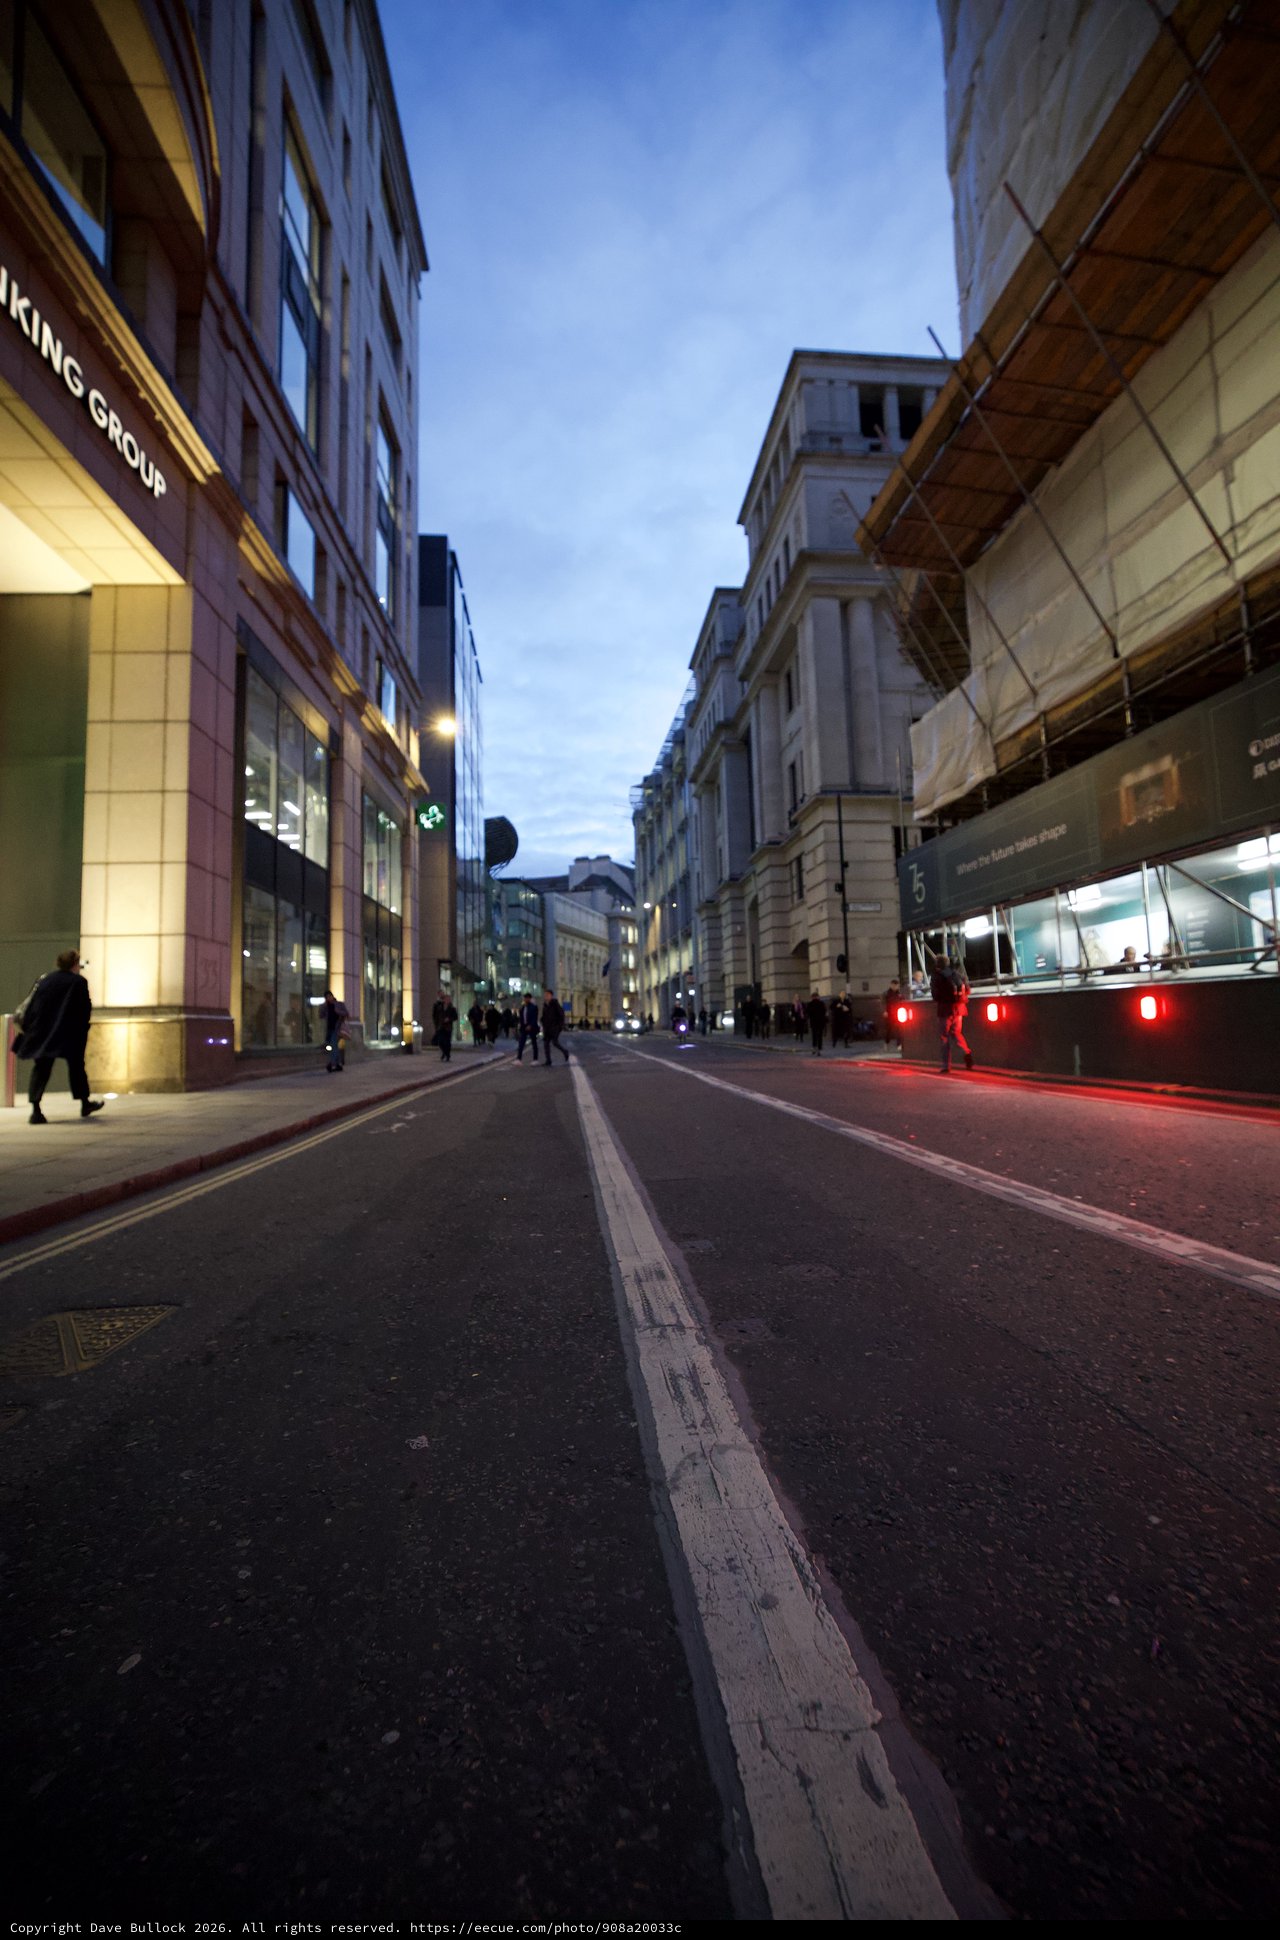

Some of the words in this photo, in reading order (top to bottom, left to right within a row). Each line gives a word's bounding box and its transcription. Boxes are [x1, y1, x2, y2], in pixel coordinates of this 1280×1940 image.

[89, 389, 168, 499] GROUP
[957, 860, 978, 876] Where
[978, 855, 991, 868] the
[991, 845, 1015, 861] future
[1015, 836, 1038, 852] takes
[1038, 823, 1067, 842] shape
[909, 863, 926, 903] 75
